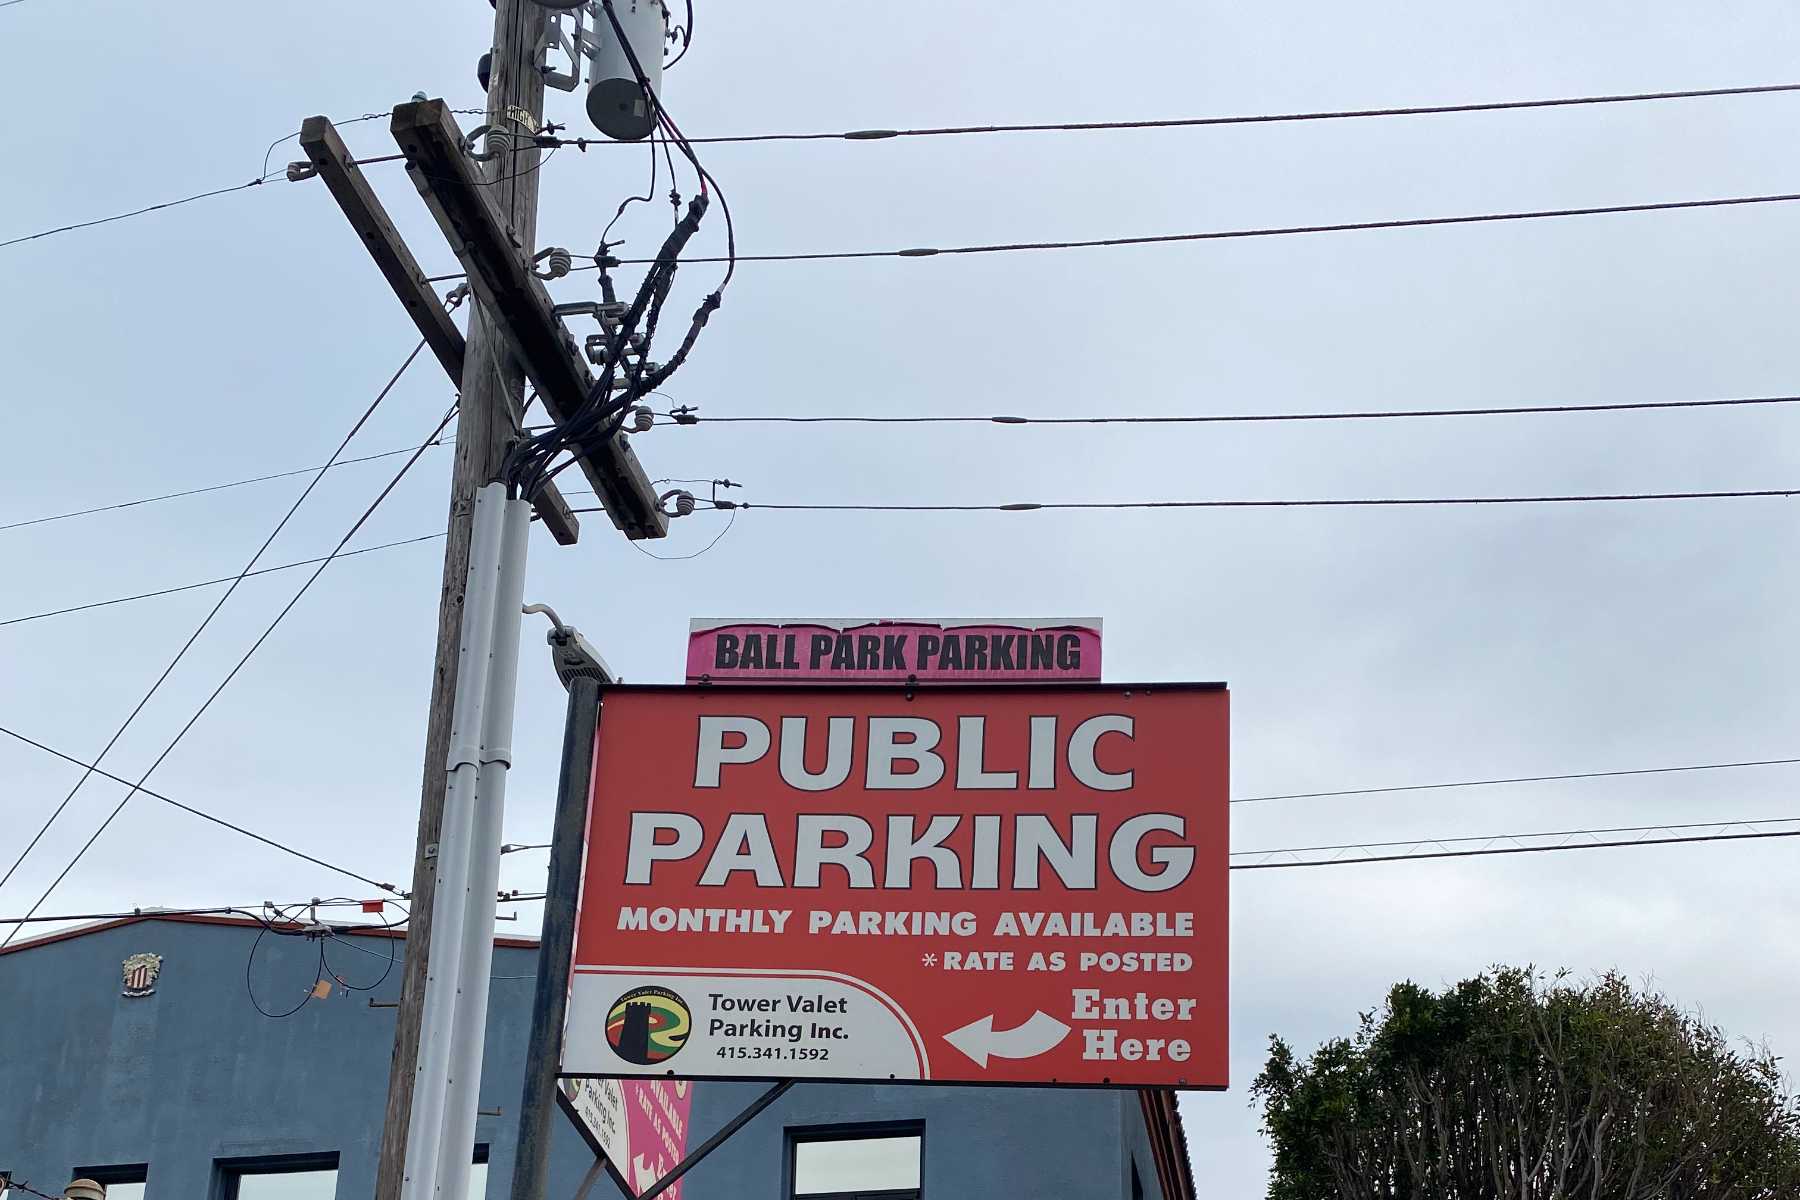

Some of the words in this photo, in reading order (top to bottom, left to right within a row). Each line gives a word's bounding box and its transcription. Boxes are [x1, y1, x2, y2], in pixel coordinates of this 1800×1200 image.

[715, 633, 801, 669] BALL
[808, 634, 909, 670] PARK
[916, 634, 1082, 671] PARKING
[693, 714, 1136, 792] PUBLIC
[622, 811, 1197, 892] PARKING
[616, 907, 792, 934] MONTHLY
[808, 910, 977, 936] PARKING
[993, 911, 1194, 937] AVAILABLE
[1027, 951, 1066, 972] AS
[1079, 951, 1193, 972] POSTED
[708, 993, 781, 1013] Tower
[786, 994, 848, 1014] Valet
[1071, 987, 1197, 1021] Enter
[709, 1018, 802, 1043] Parking
[810, 1022, 850, 1040] Inc.
[1082, 1027, 1191, 1062] Here
[716, 1046, 830, 1061] 415.341.1592
